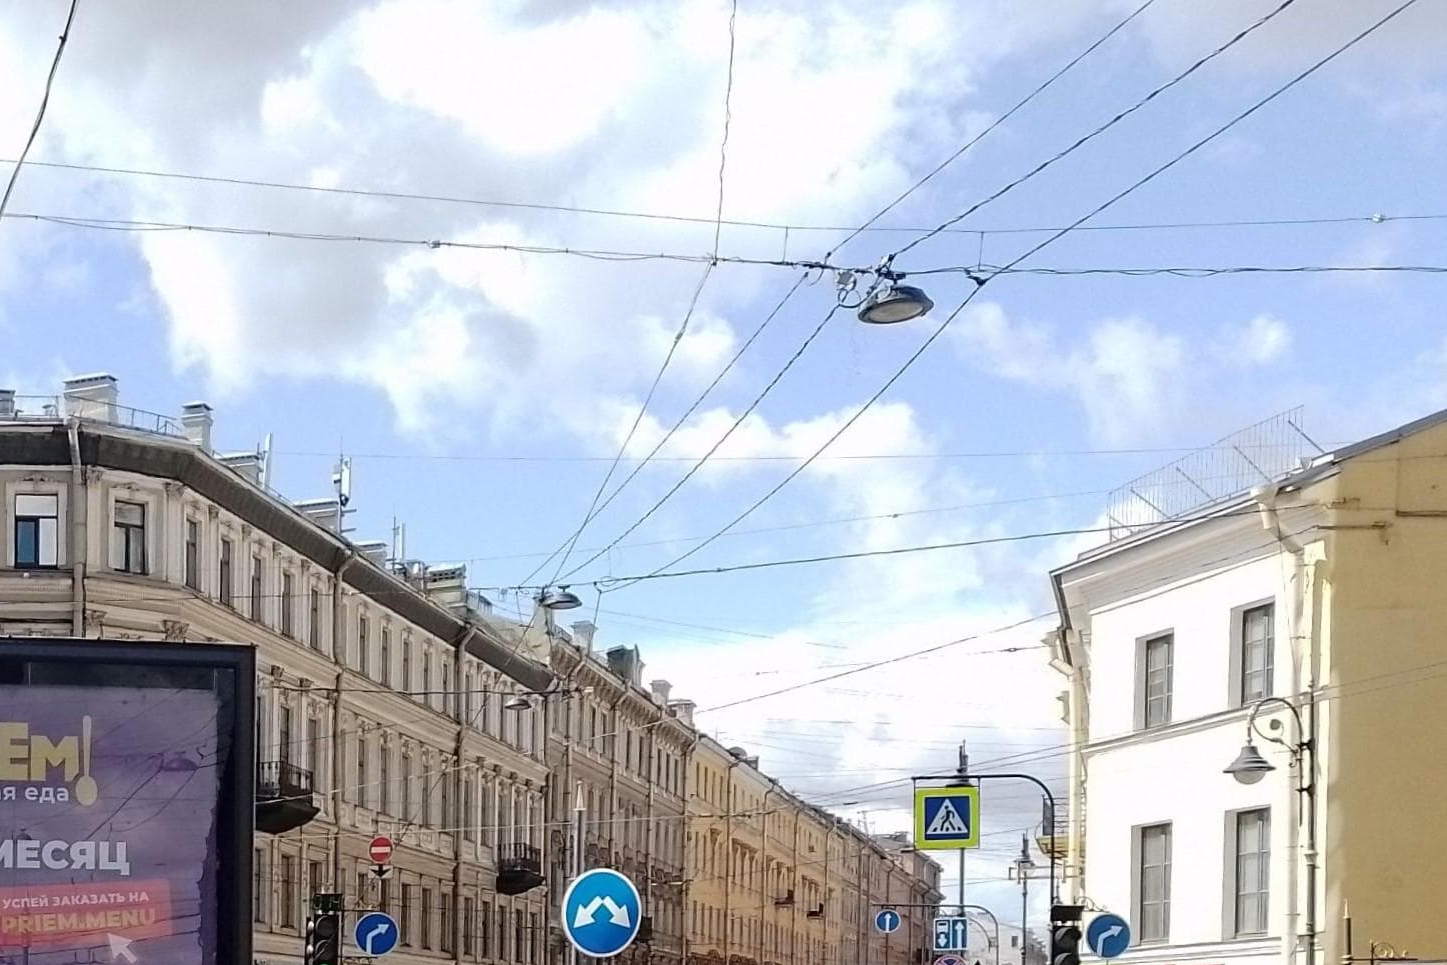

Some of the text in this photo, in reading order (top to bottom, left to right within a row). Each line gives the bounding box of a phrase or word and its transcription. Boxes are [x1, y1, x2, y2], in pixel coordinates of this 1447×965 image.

[24, 785, 69, 803] еда
[3, 891, 150, 909] УСПЕЙ ЗАКАЗАТЬ НА
[2, 908, 156, 933] PRIEM.MENU
